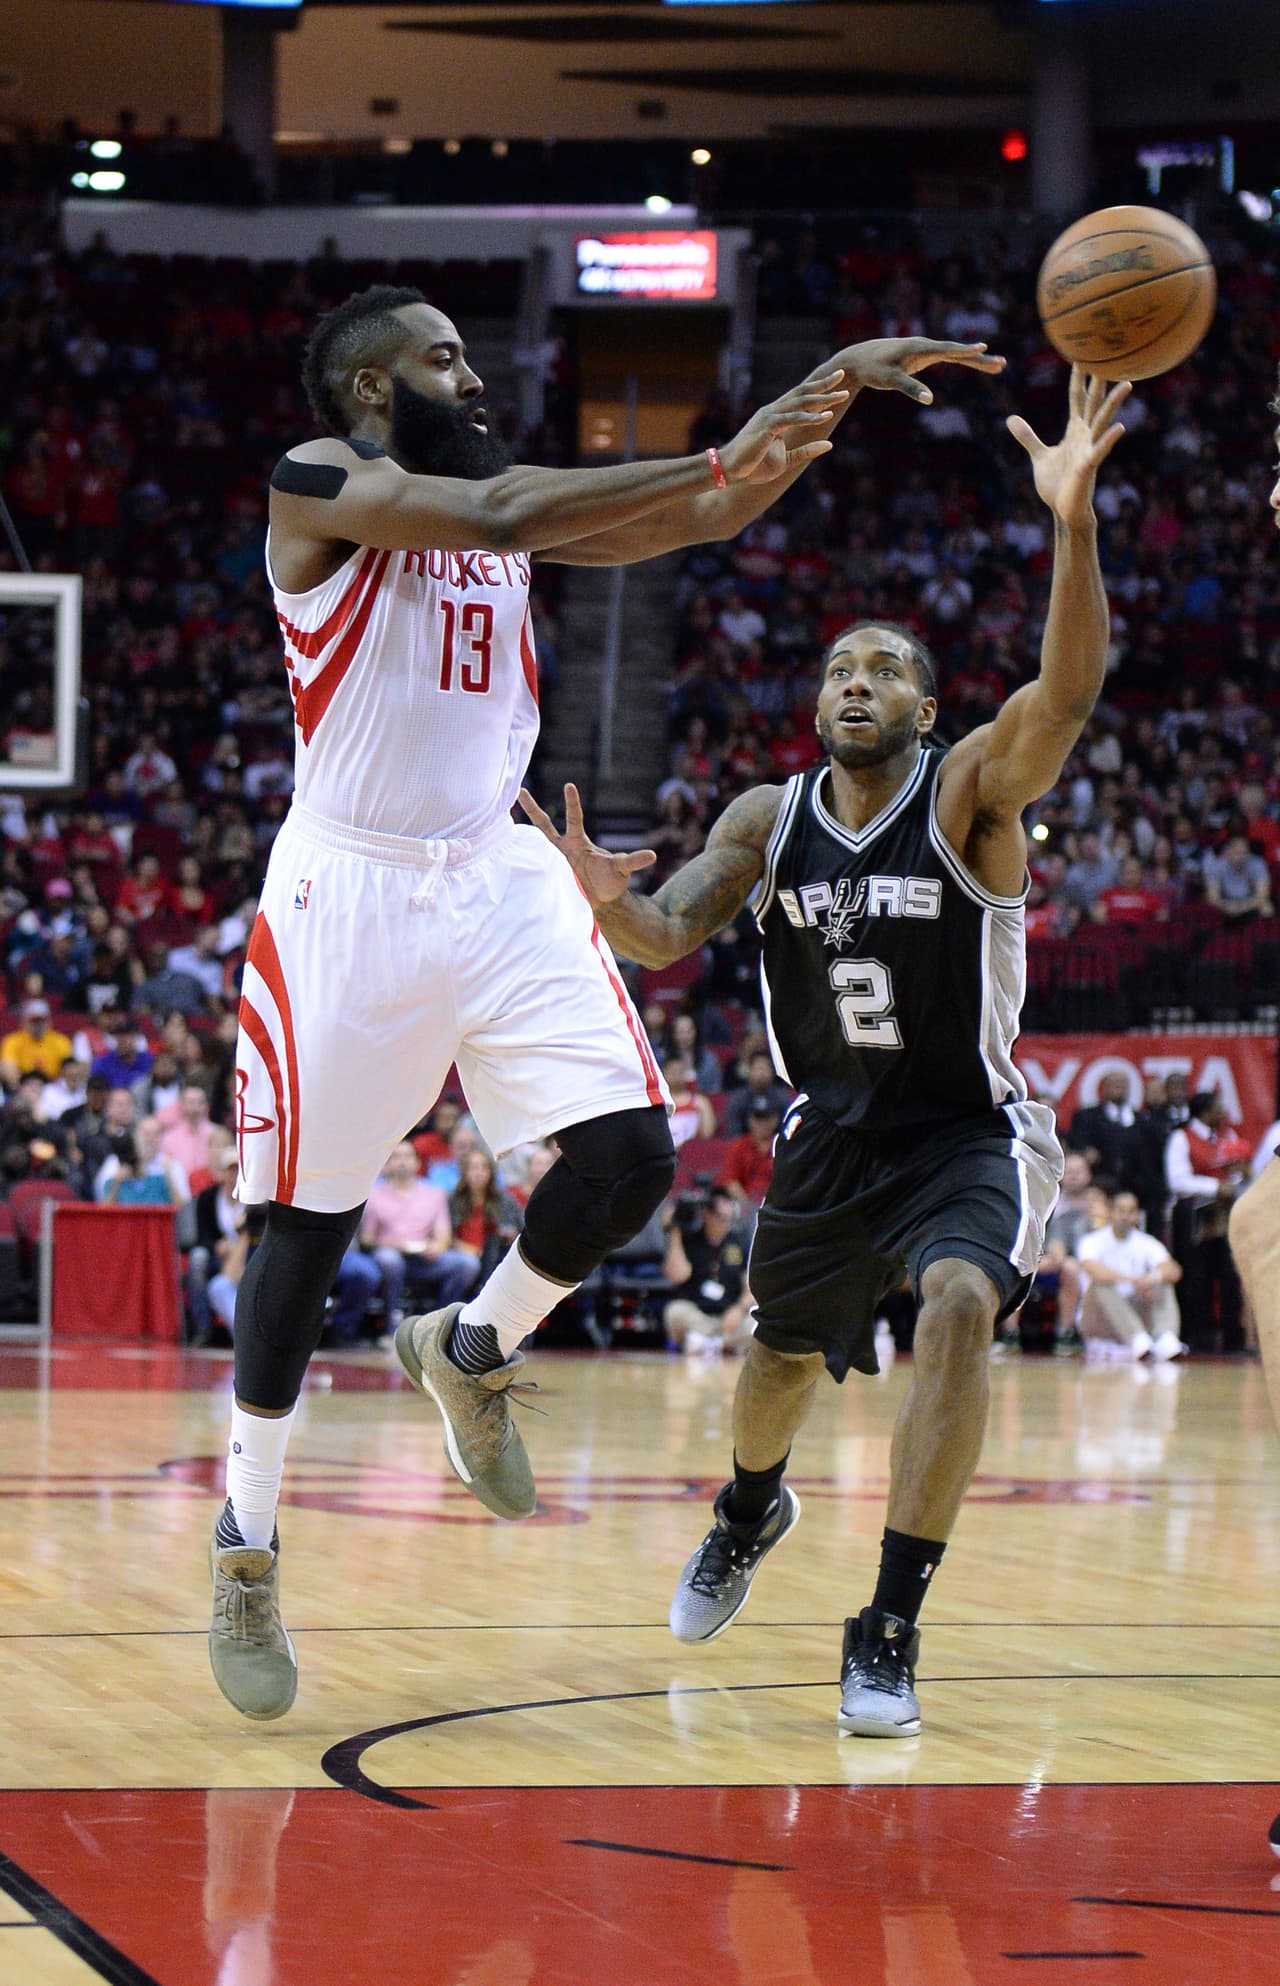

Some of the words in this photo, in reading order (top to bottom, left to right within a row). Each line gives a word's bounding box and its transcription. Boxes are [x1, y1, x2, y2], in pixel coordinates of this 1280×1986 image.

[440, 599, 494, 694] 13
[777, 875, 943, 952] SPURS
[828, 957, 905, 1050] 2
